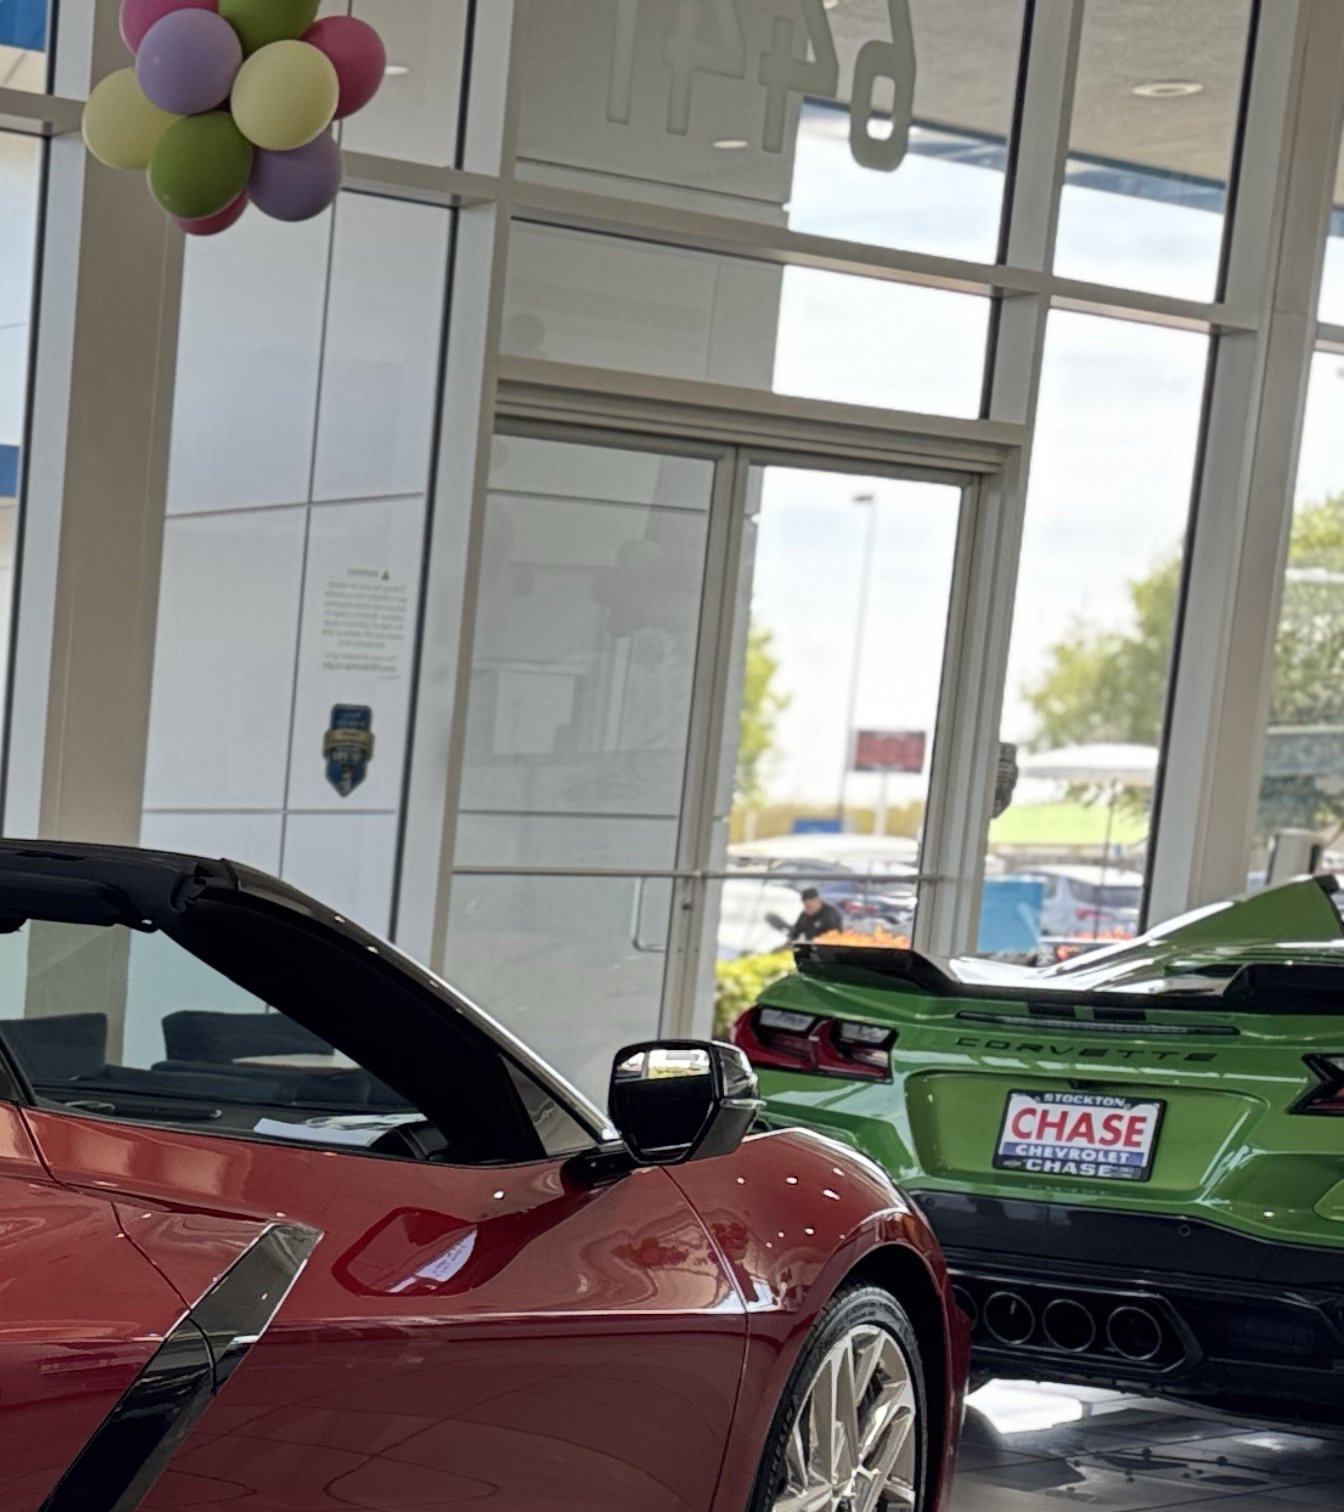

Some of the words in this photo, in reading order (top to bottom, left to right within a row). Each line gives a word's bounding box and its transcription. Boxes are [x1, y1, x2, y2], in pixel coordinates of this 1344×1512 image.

[954, 1036, 1218, 1063] CORVETTE
[1043, 1092, 1126, 1107] STOCKTON
[1011, 1106, 1148, 1149] CHASE
[1015, 1143, 1130, 1164] CHEVROLET
[1025, 1158, 1113, 1178] CHASE
